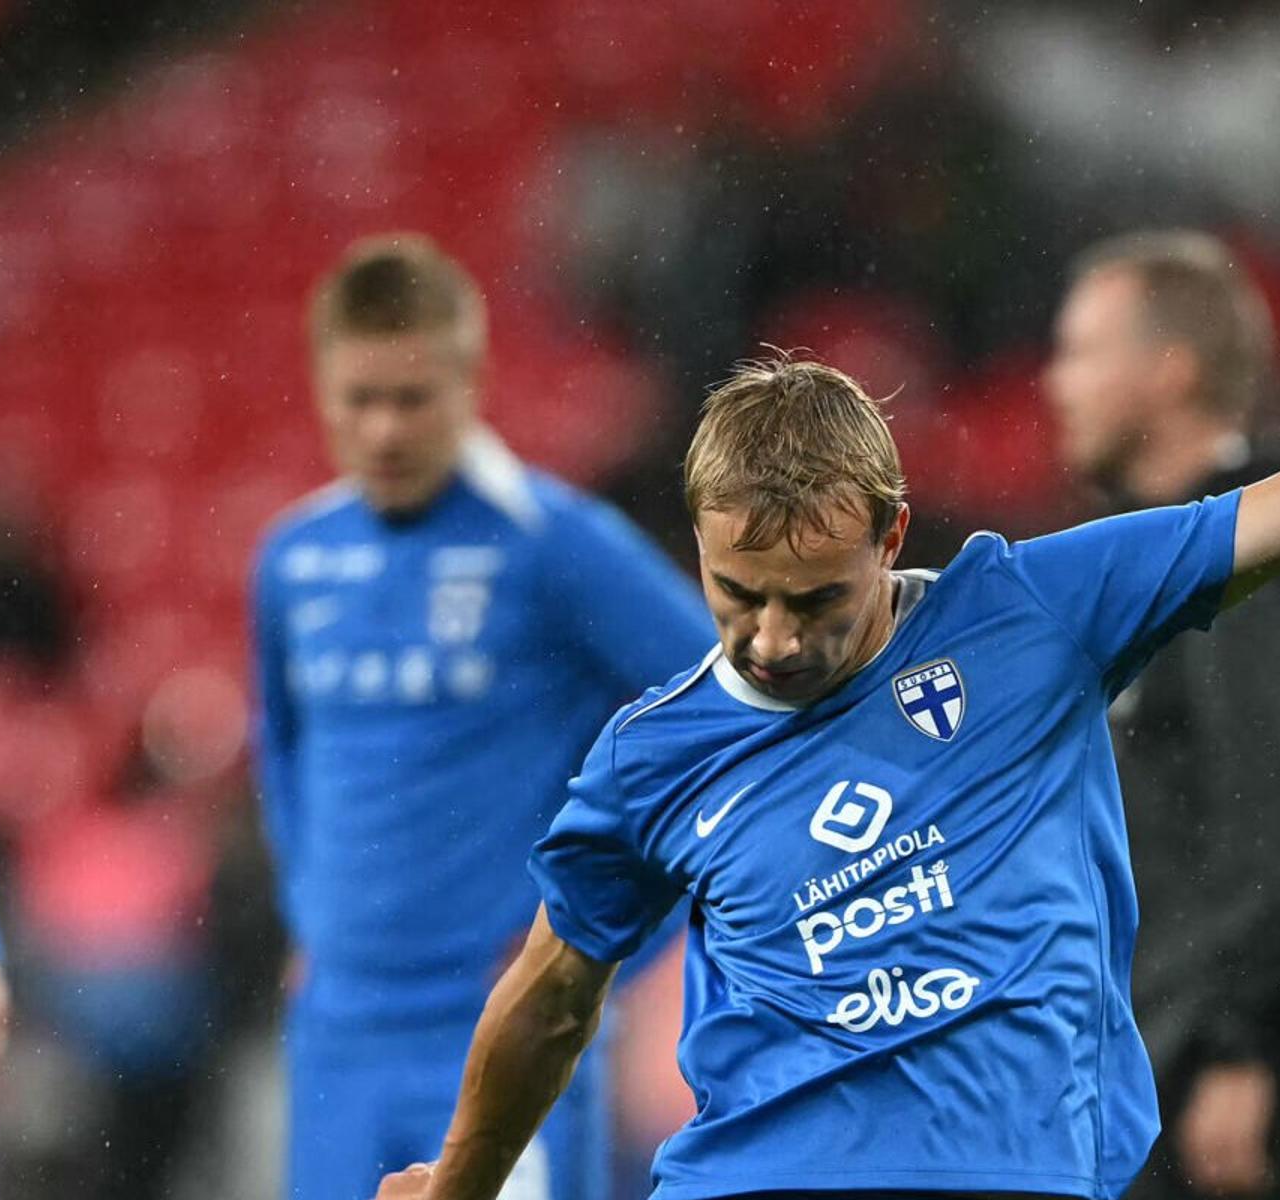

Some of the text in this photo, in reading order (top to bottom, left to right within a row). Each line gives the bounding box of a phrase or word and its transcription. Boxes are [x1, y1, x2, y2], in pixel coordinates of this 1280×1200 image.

[900, 663, 946, 690] SUOMI
[793, 824, 946, 912] LÄHITAPIOLA
[795, 860, 955, 976] posti
[826, 966, 981, 1033] elisa
